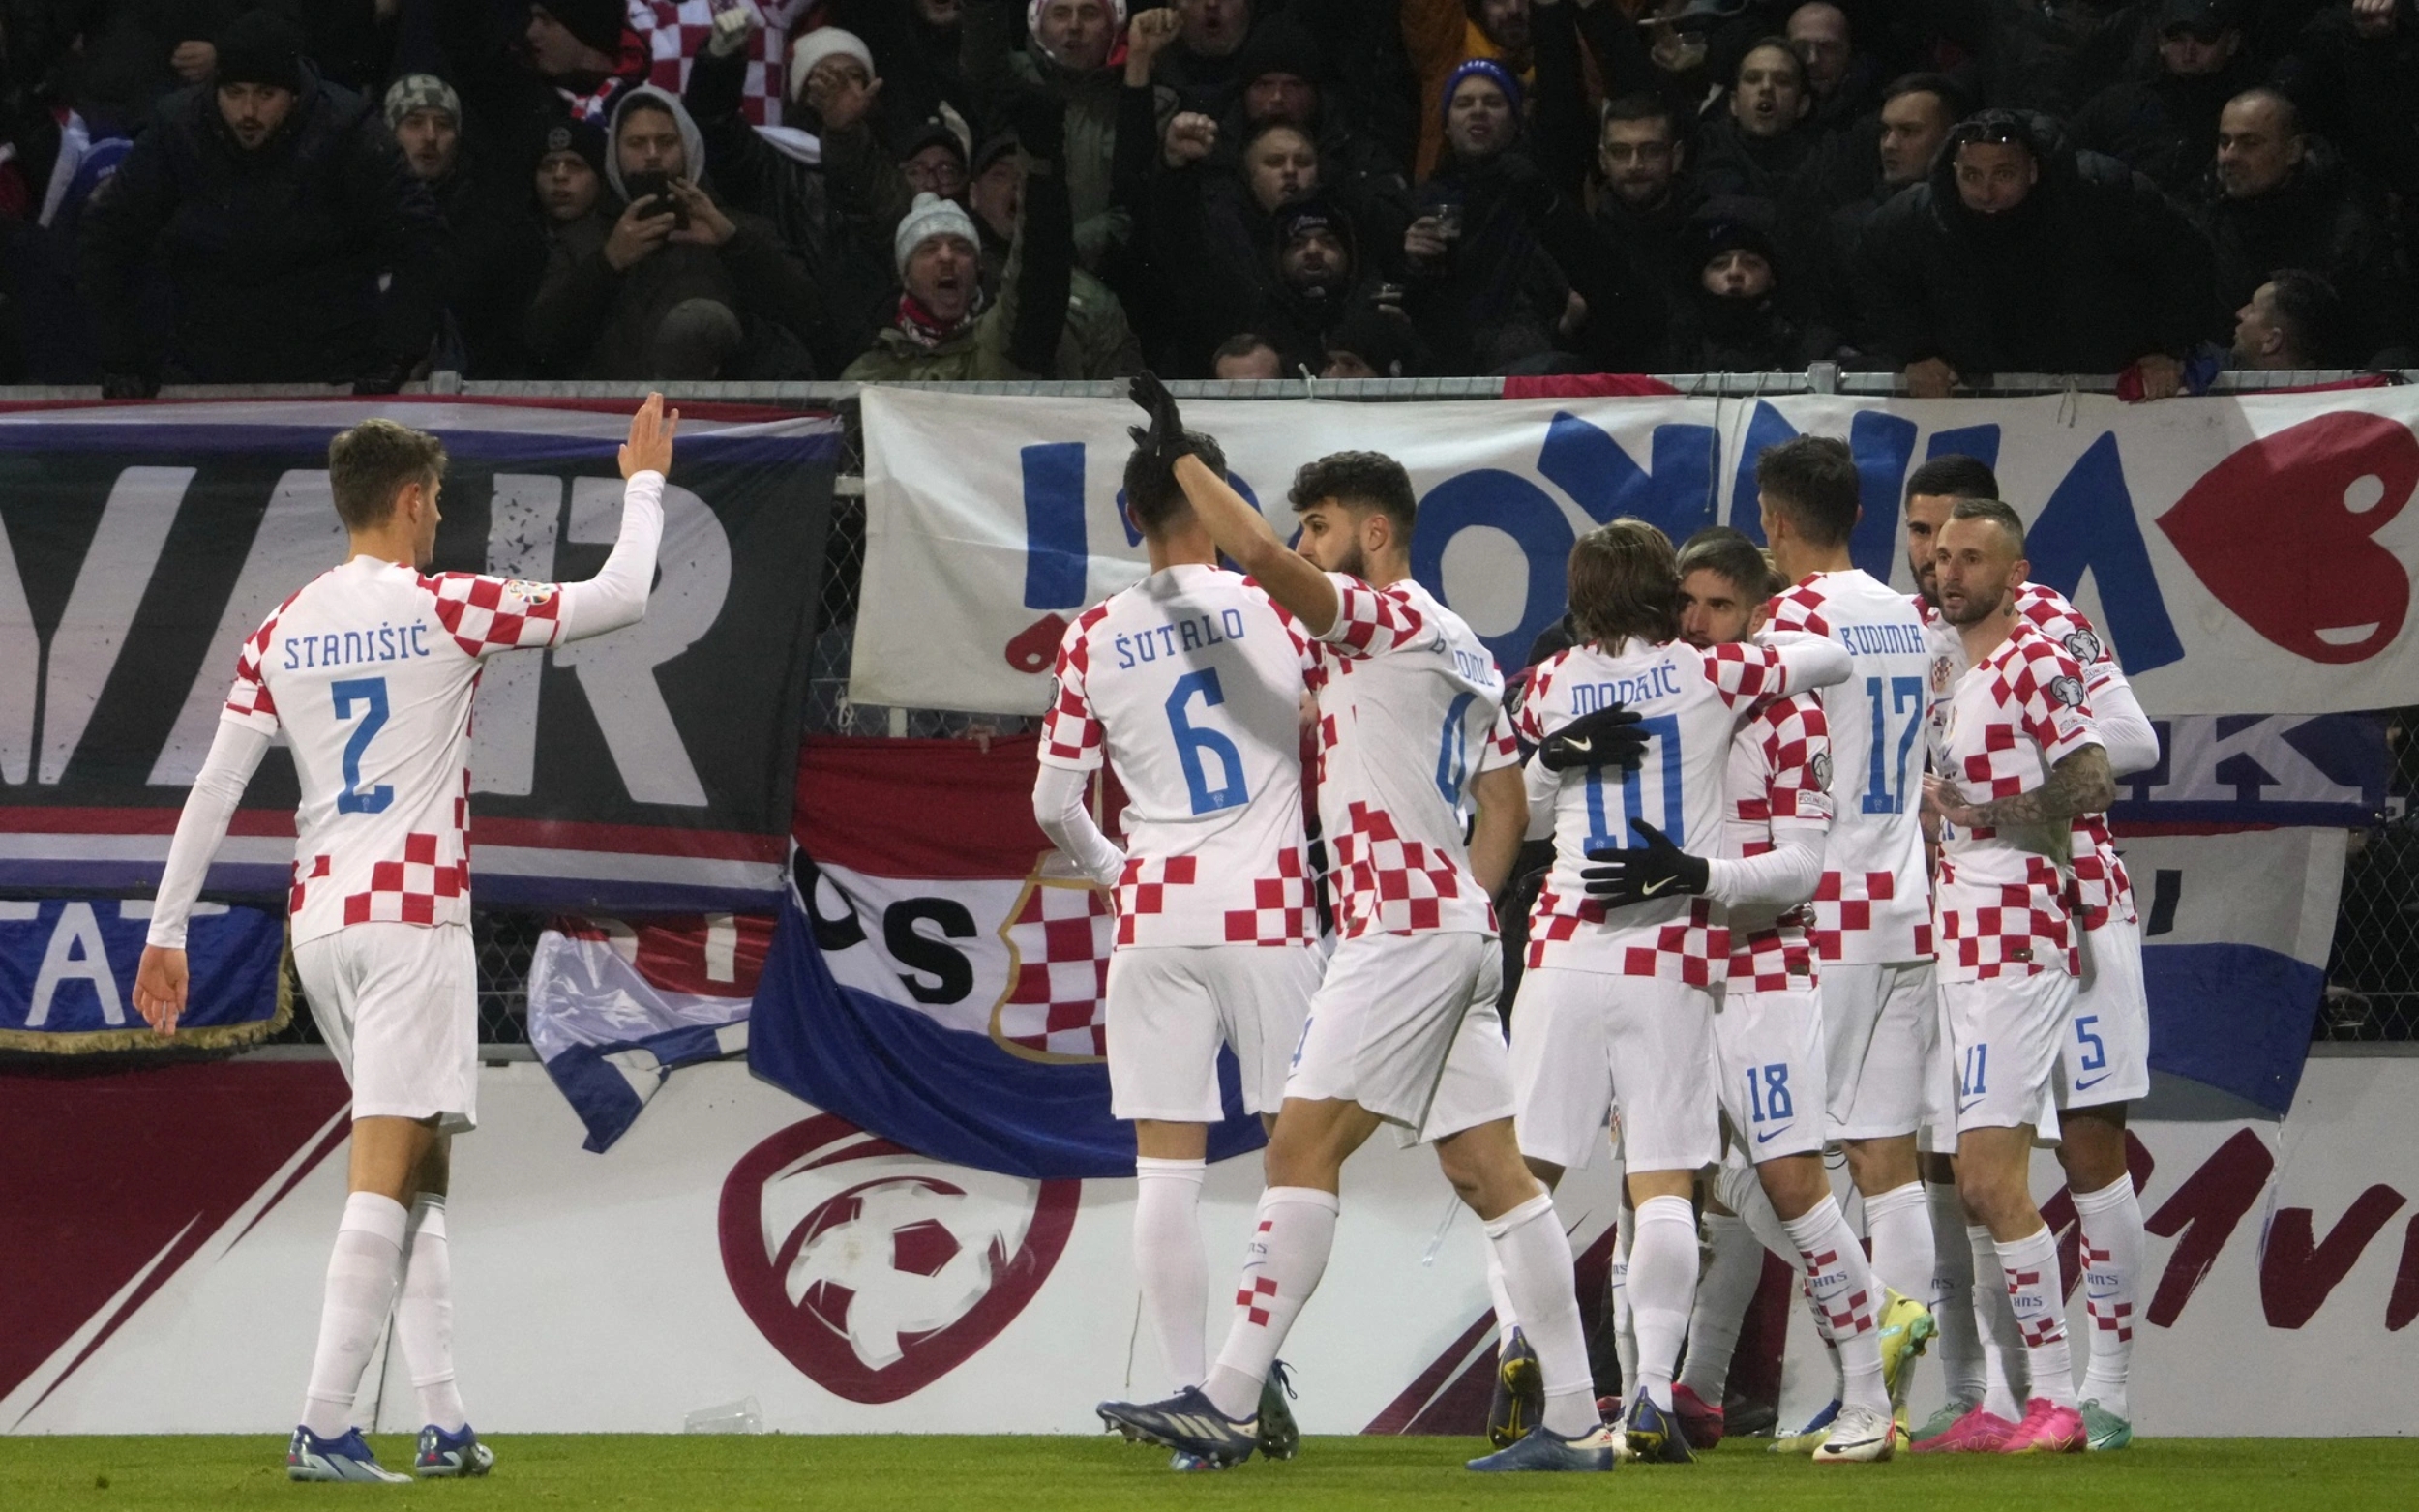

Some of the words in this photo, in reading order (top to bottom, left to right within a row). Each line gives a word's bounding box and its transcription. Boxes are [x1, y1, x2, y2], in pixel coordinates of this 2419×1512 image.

[284, 618, 431, 669] STANIŠIĆ
[1115, 608, 1245, 669] ŠUTALO
[1840, 624, 1926, 656] BUDIMIR
[331, 676, 395, 815] 2
[1165, 666, 1250, 815] 6
[1862, 676, 1923, 815] 17
[1961, 1043, 1987, 1097] 11
[2074, 1015, 2107, 1071] 5
[1747, 1062, 1793, 1123] 18
